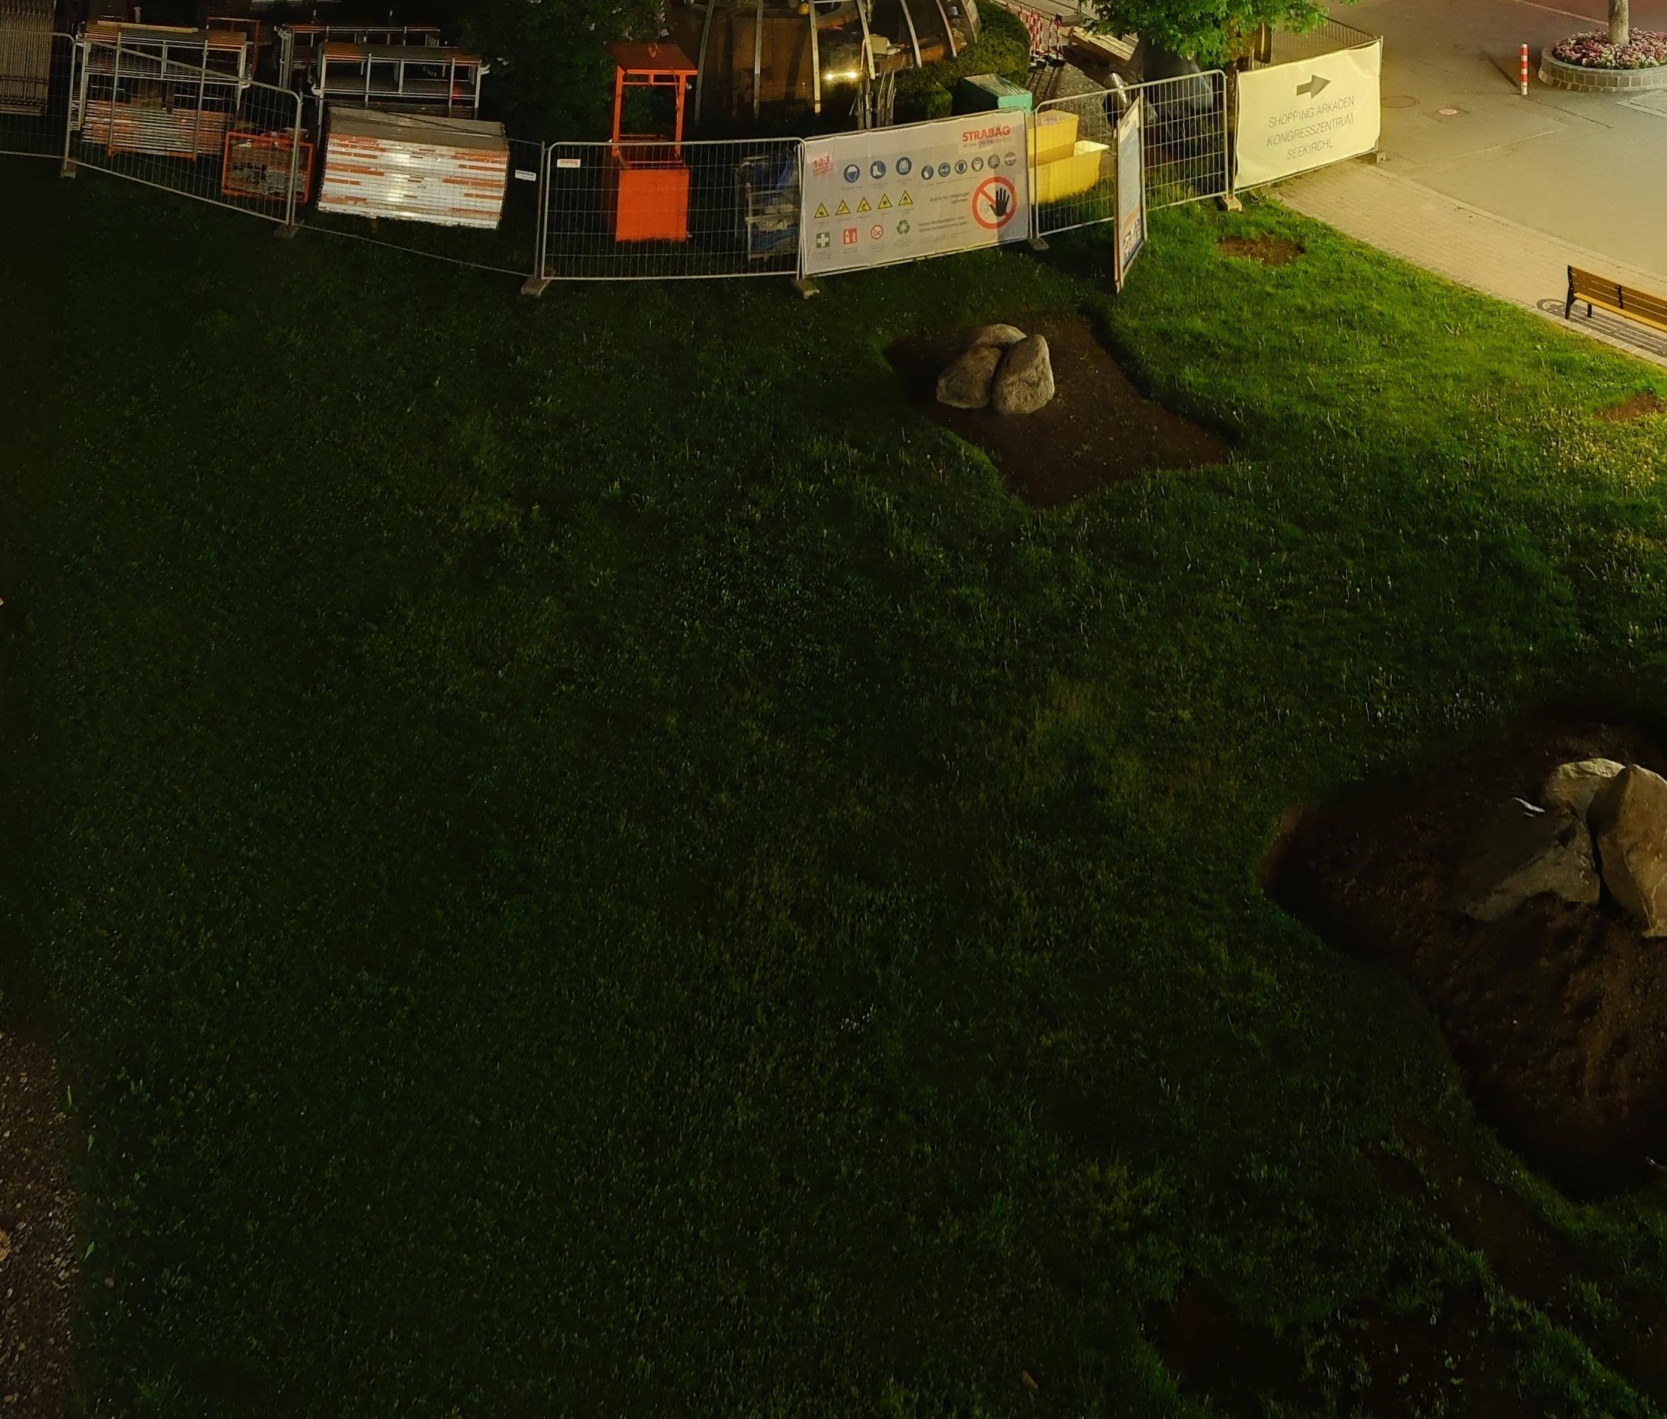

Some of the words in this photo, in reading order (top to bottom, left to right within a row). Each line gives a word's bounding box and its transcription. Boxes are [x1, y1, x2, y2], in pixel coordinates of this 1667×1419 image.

[1268, 106, 1315, 129] SHOPPING
[1316, 95, 1355, 116] ARKADEN
[962, 125, 1011, 142] STRABAG
[1266, 112, 1354, 147] KONGRESSZENTRUM
[1287, 137, 1334, 161] SEEKIRCHL
